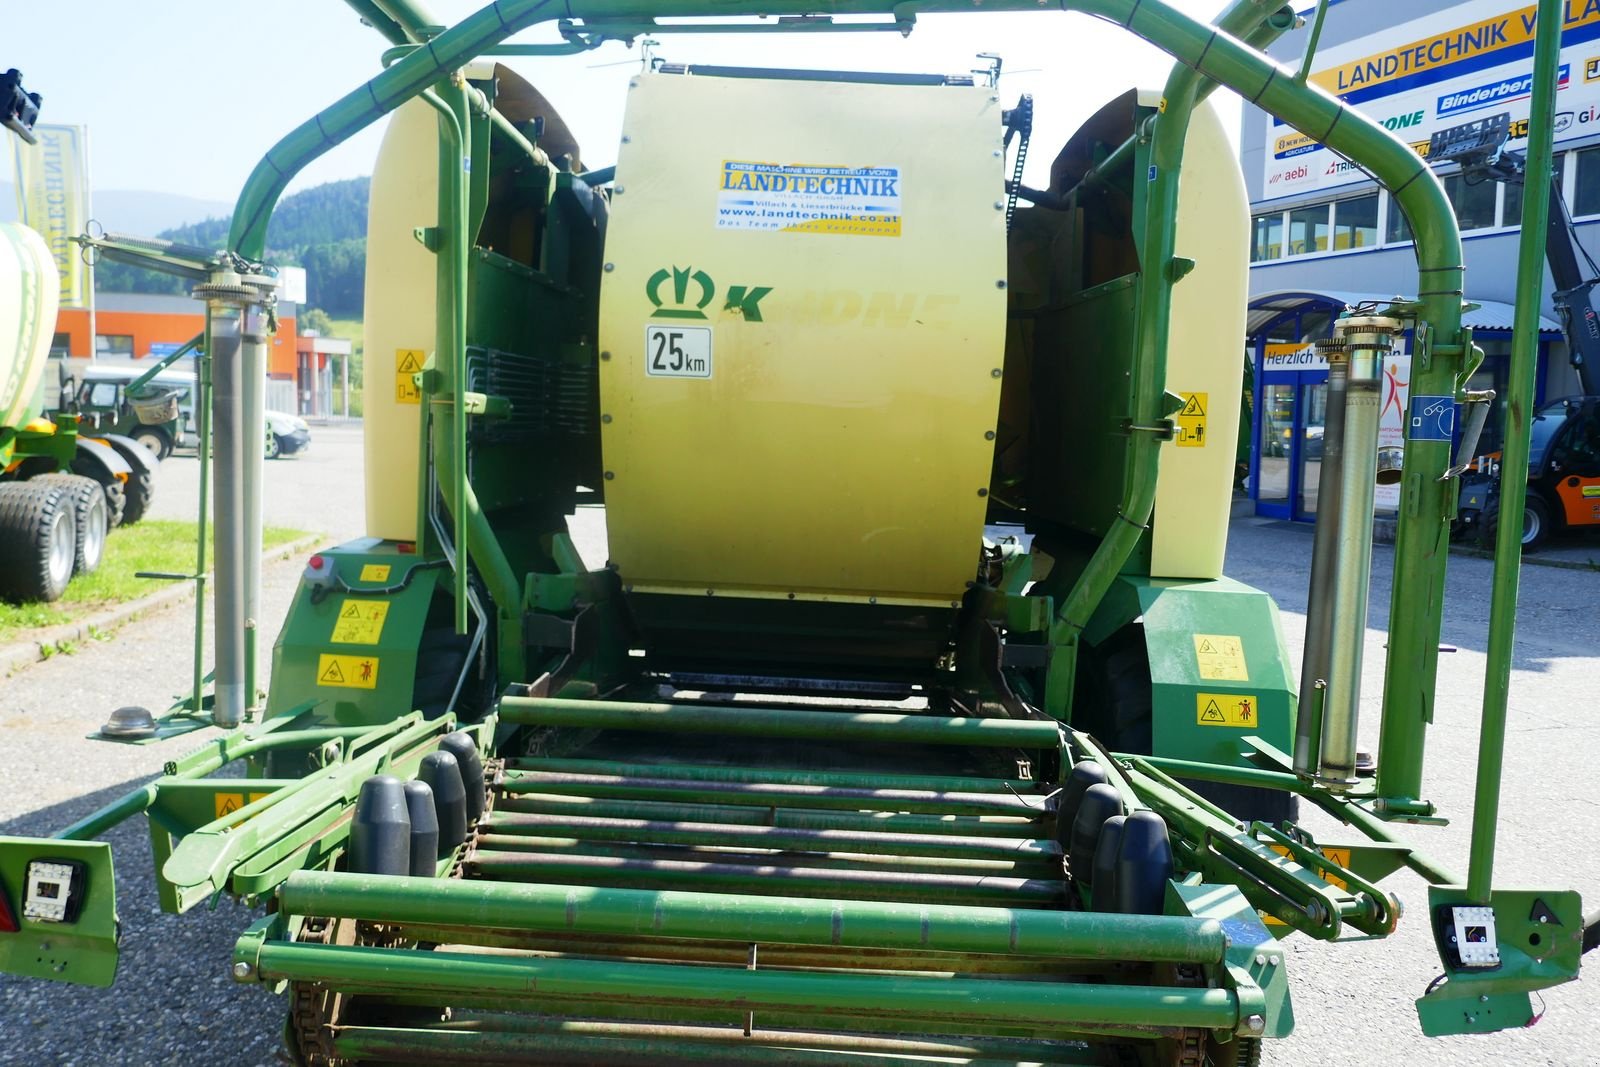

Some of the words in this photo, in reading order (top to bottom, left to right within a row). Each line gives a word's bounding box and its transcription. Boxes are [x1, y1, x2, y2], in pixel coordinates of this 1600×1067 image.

[1337, 20, 1511, 91] LANDTECHNIK
[1440, 69, 1567, 111] Binderberr
[1286, 139, 1298, 147] NEW
[1285, 145, 1314, 157] AGRICULTURE
[730, 163, 755, 172] DIESE
[757, 164, 801, 174] MASCHINE
[804, 167, 828, 175] WIRD
[829, 168, 867, 176] BETREUT
[869, 169, 892, 177] VON:
[1285, 165, 1308, 181] aebi
[723, 171, 898, 197] LANDTECHNIK
[755, 200, 787, 208] Villach
[801, 202, 863, 211] Lieserbrücke
[720, 208, 898, 223] www.landtechnik.co.at
[719, 219, 741, 227] Das
[749, 220, 779, 229] Team
[786, 222, 820, 231] Ihres
[1266, 349, 1313, 365] Herzlich
